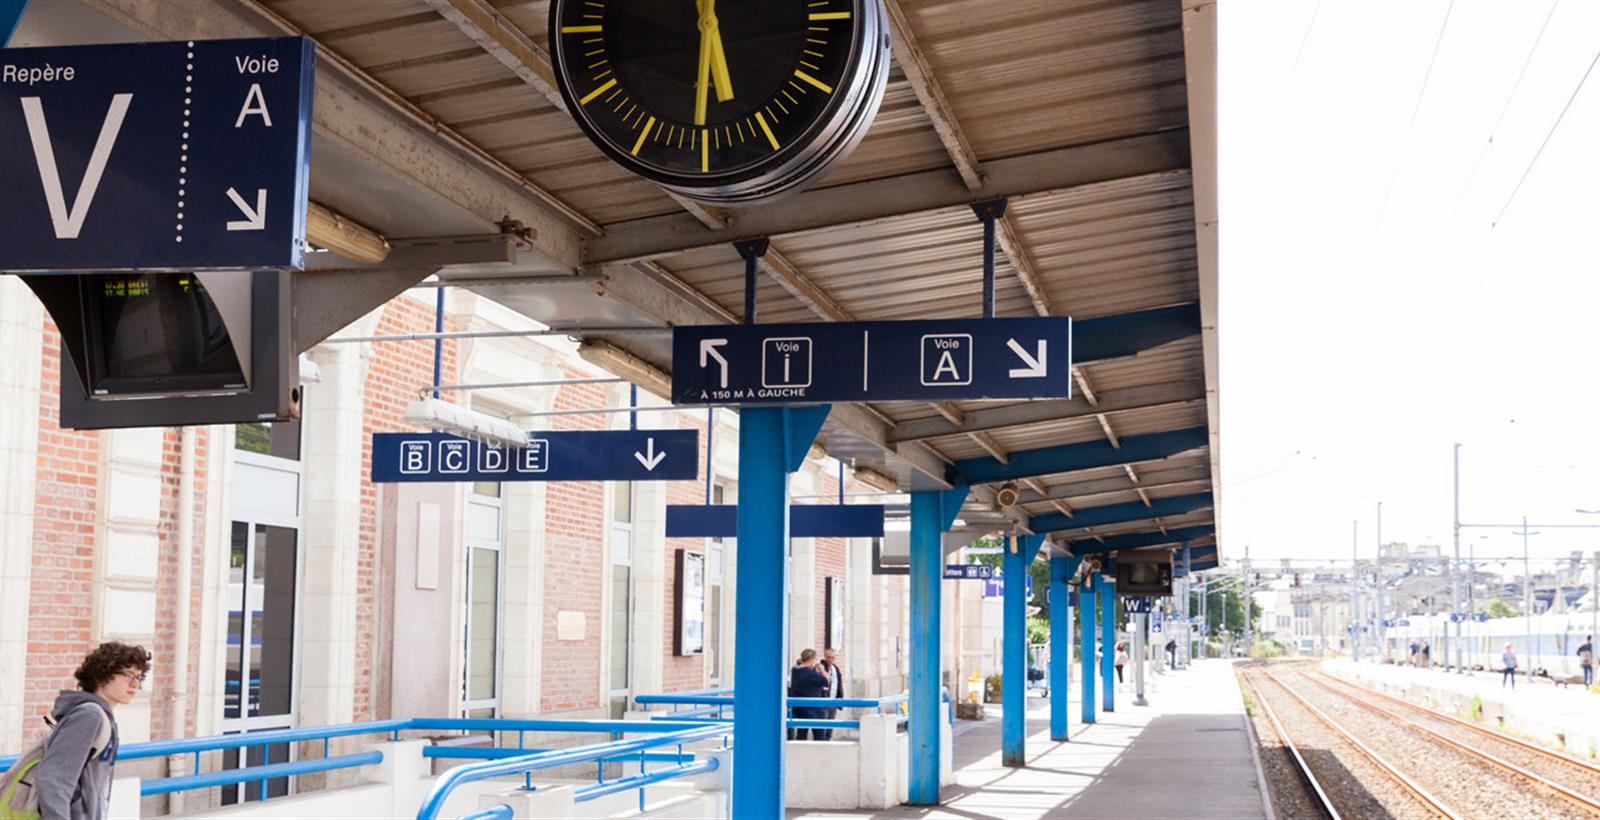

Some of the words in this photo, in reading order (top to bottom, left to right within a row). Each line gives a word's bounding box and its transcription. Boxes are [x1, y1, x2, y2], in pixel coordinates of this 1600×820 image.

[3, 63, 75, 85] Repère
[235, 54, 280, 75] Voie
[235, 83, 272, 128] A
[20, 93, 133, 239] V
[775, 341, 800, 353] Voie
[934, 337, 960, 349] Voie
[783, 353, 790, 383] i
[933, 351, 960, 381] A
[700, 387, 709, 399] À
[712, 390, 731, 399] 150
[733, 390, 744, 398] M
[746, 385, 755, 398] À
[757, 387, 806, 398] GAUCHE
[408, 443, 424, 451] Voie
[447, 443, 462, 451] Voie
[407, 451, 423, 471] B
[446, 450, 463, 470] C
[485, 450, 502, 469] D
[525, 449, 540, 469] E
[1125, 599, 1140, 612] W
